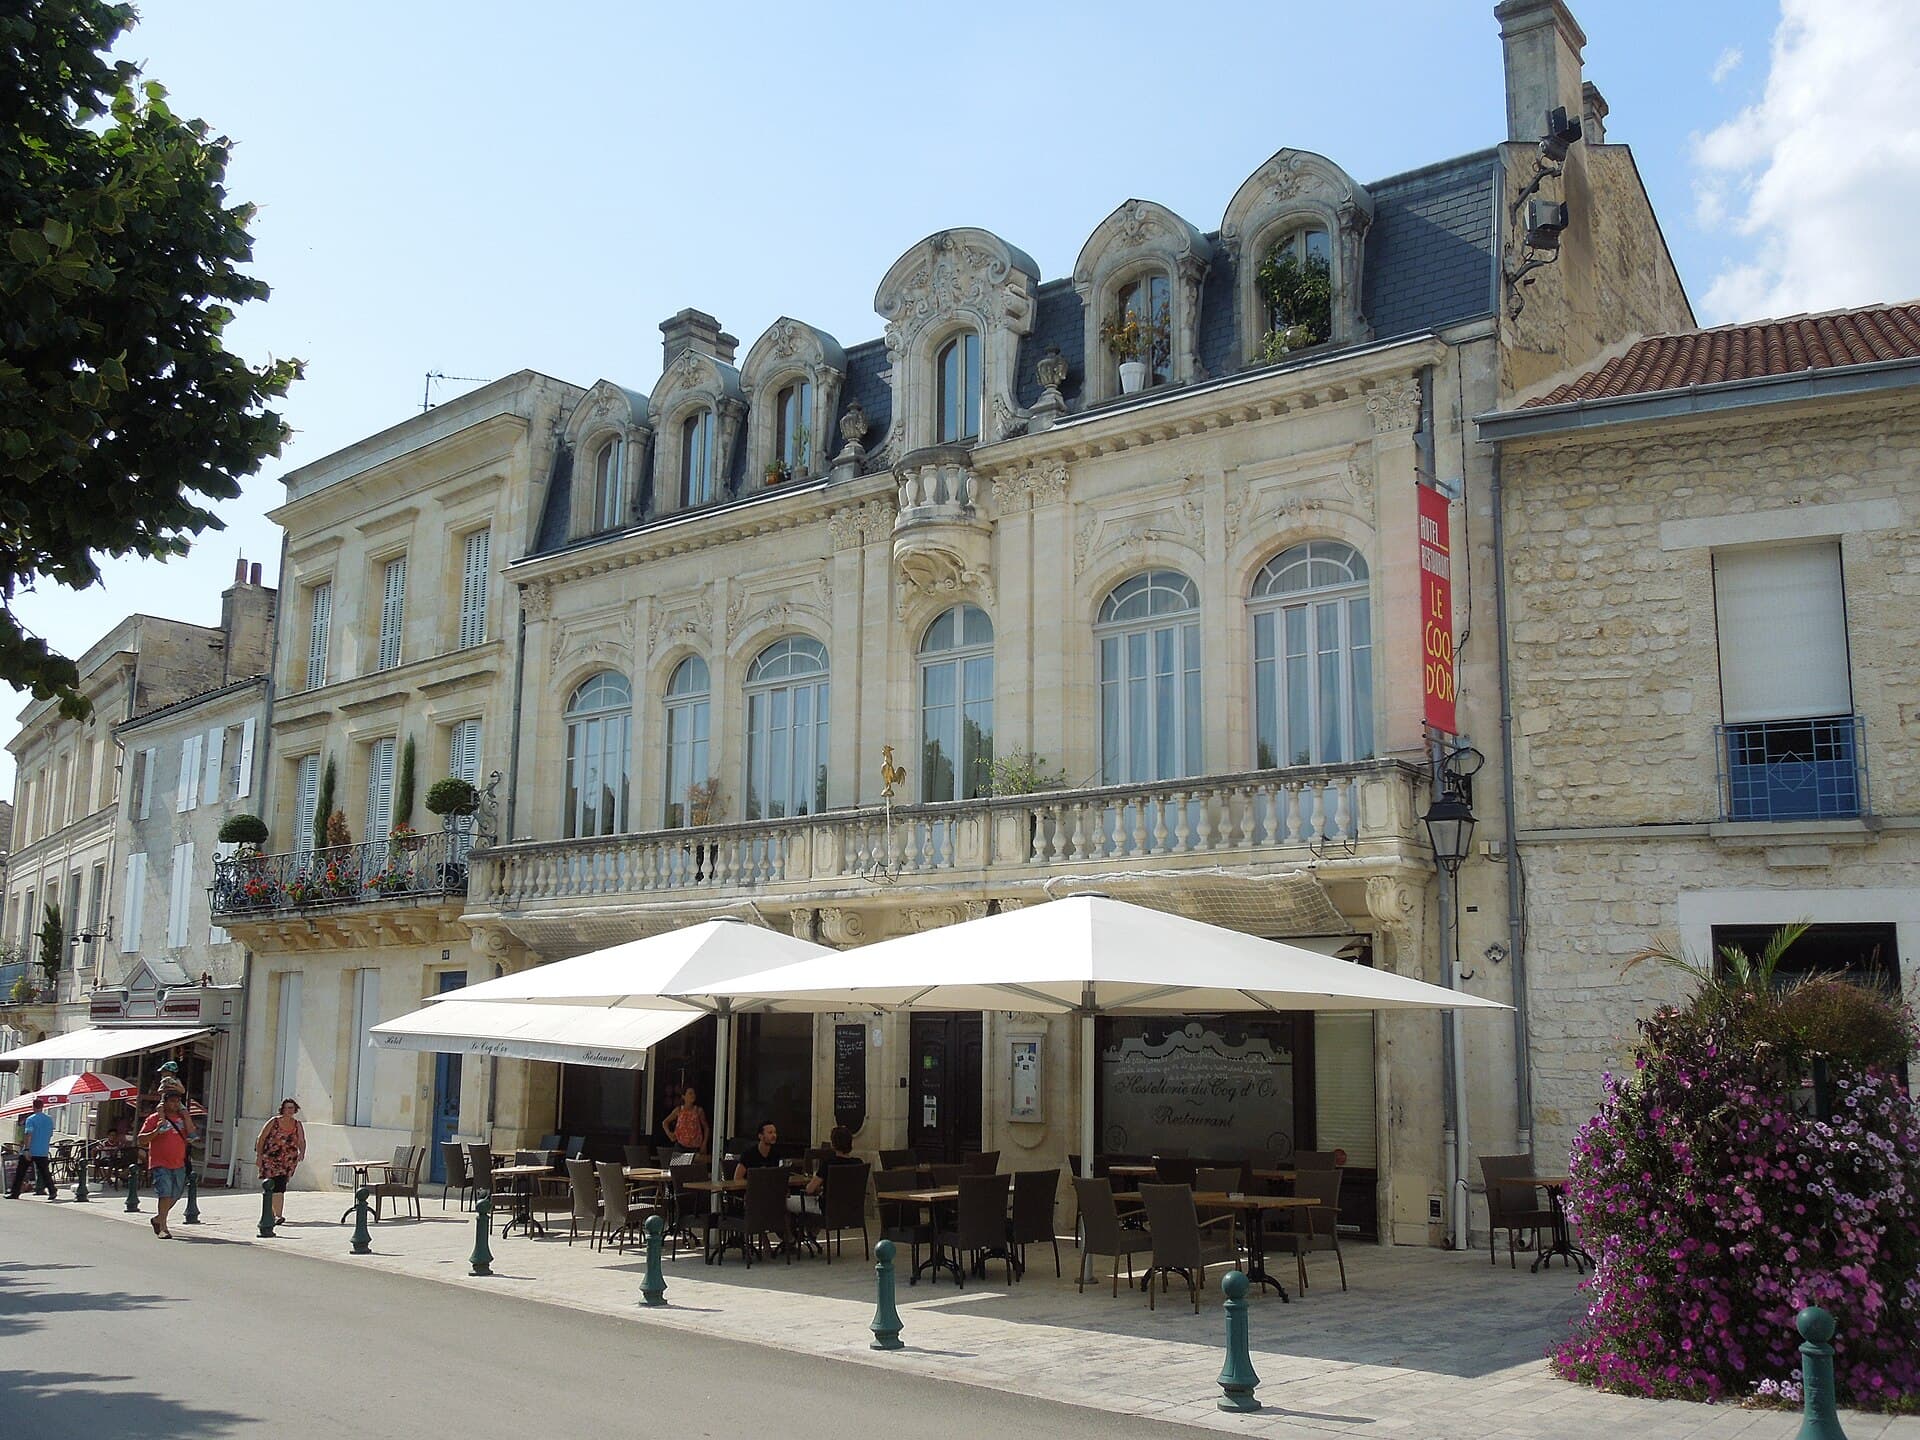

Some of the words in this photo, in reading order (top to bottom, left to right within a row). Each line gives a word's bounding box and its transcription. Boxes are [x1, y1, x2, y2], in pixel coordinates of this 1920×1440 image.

[1420, 515, 1440, 547] HOTEL
[1431, 581, 1443, 619] LE
[1426, 620, 1452, 666] COQ
[1426, 662, 1455, 703] D'OR
[582, 1051, 624, 1063] Restaurant
[1190, 1082, 1208, 1096] du
[1208, 1075, 1238, 1103] Coq
[1152, 1104, 1235, 1128] Restaurant
